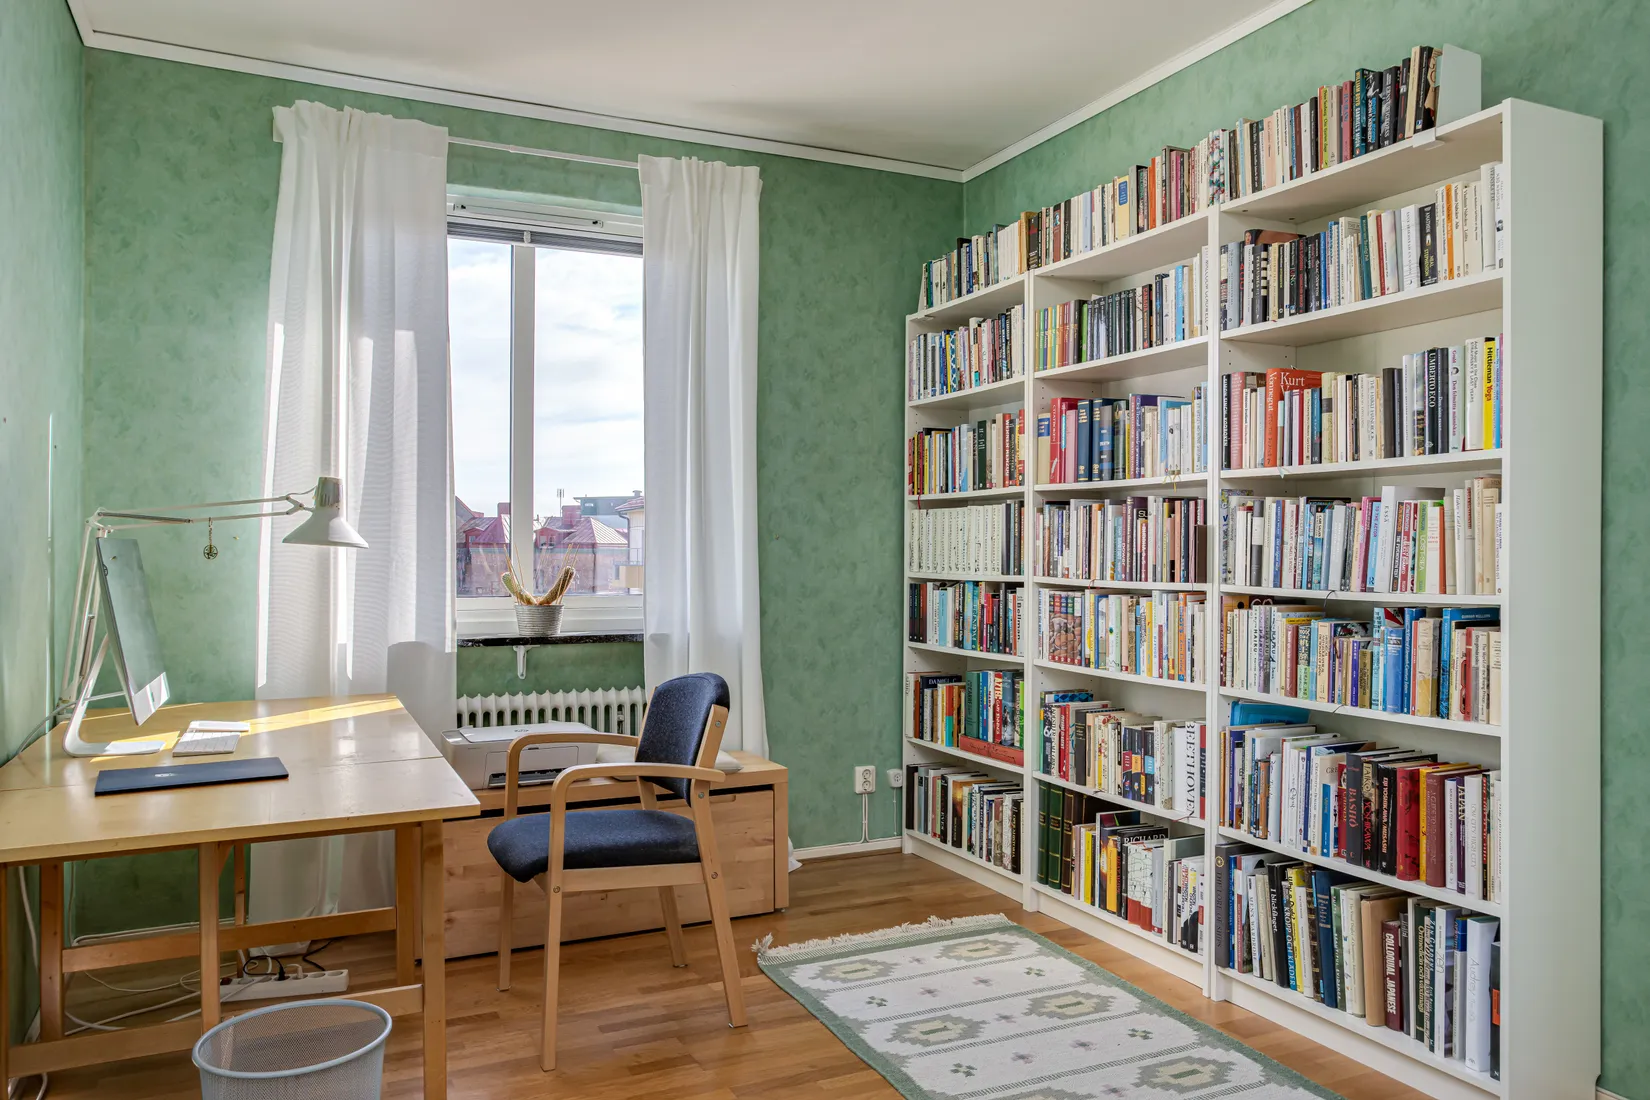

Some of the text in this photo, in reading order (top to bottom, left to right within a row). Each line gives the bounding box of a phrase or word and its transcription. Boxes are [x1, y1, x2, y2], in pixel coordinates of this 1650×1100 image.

[1267, 372, 1277, 412] Vonnegut
[1280, 372, 1305, 386] Kurt
[1428, 353, 1436, 407] UMBERTO ECO
[1485, 385, 1493, 402] Yoga
[994, 677, 1002, 699] AZTEC
[1186, 722, 1195, 817] BEETHOVEN
[1364, 765, 1372, 850] TAIKO YOSHIKAWA
[1456, 785, 1466, 821] JAPAN
[1124, 834, 1165, 844] RICHARD
[1385, 933, 1396, 1015] COLLOQUIAL JAPANESE
